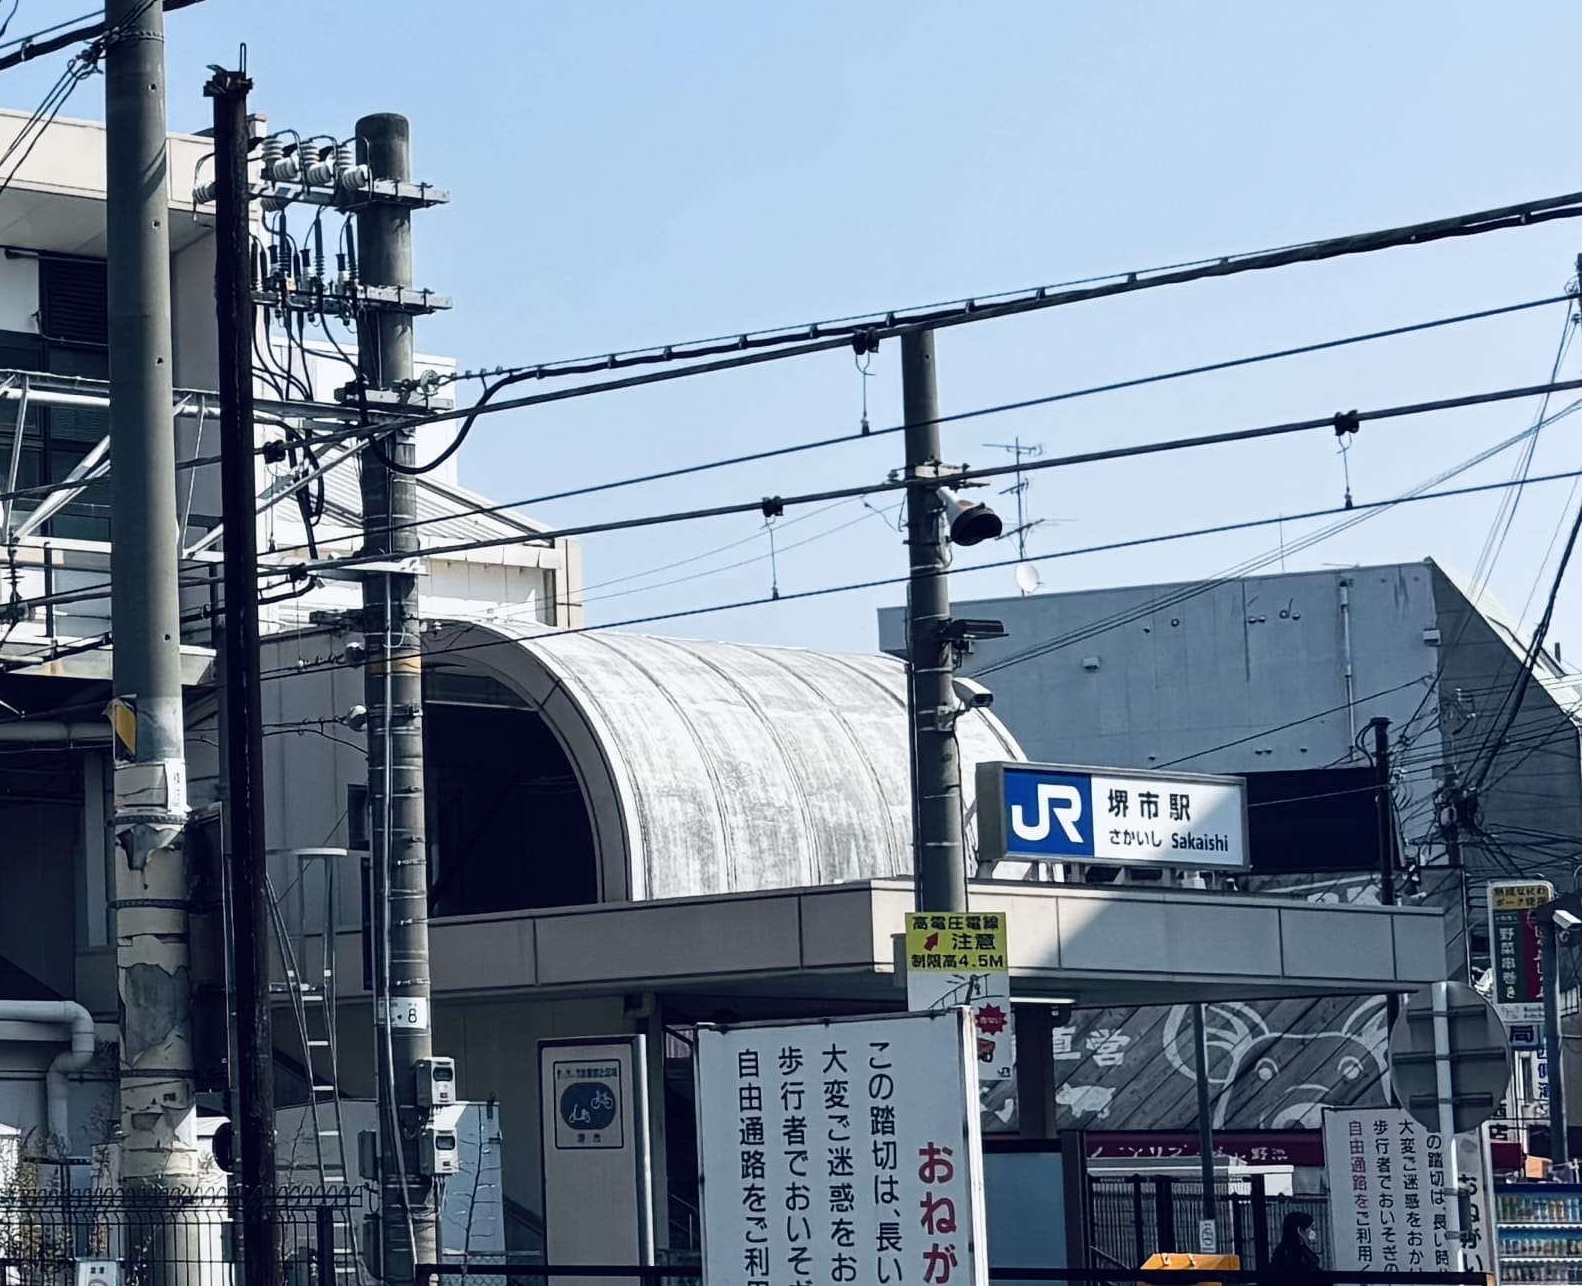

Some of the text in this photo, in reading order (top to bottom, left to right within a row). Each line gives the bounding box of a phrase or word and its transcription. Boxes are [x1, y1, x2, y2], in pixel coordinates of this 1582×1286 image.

[1012, 783, 1084, 843] JR
[1108, 789, 1191, 821] 堺市駅
[1109, 829, 1228, 852] さかいし Sakaishi
[912, 916, 999, 930] 高電圧電線
[952, 933, 996, 950] 注意
[911, 954, 1003, 968] 制限高4.5M
